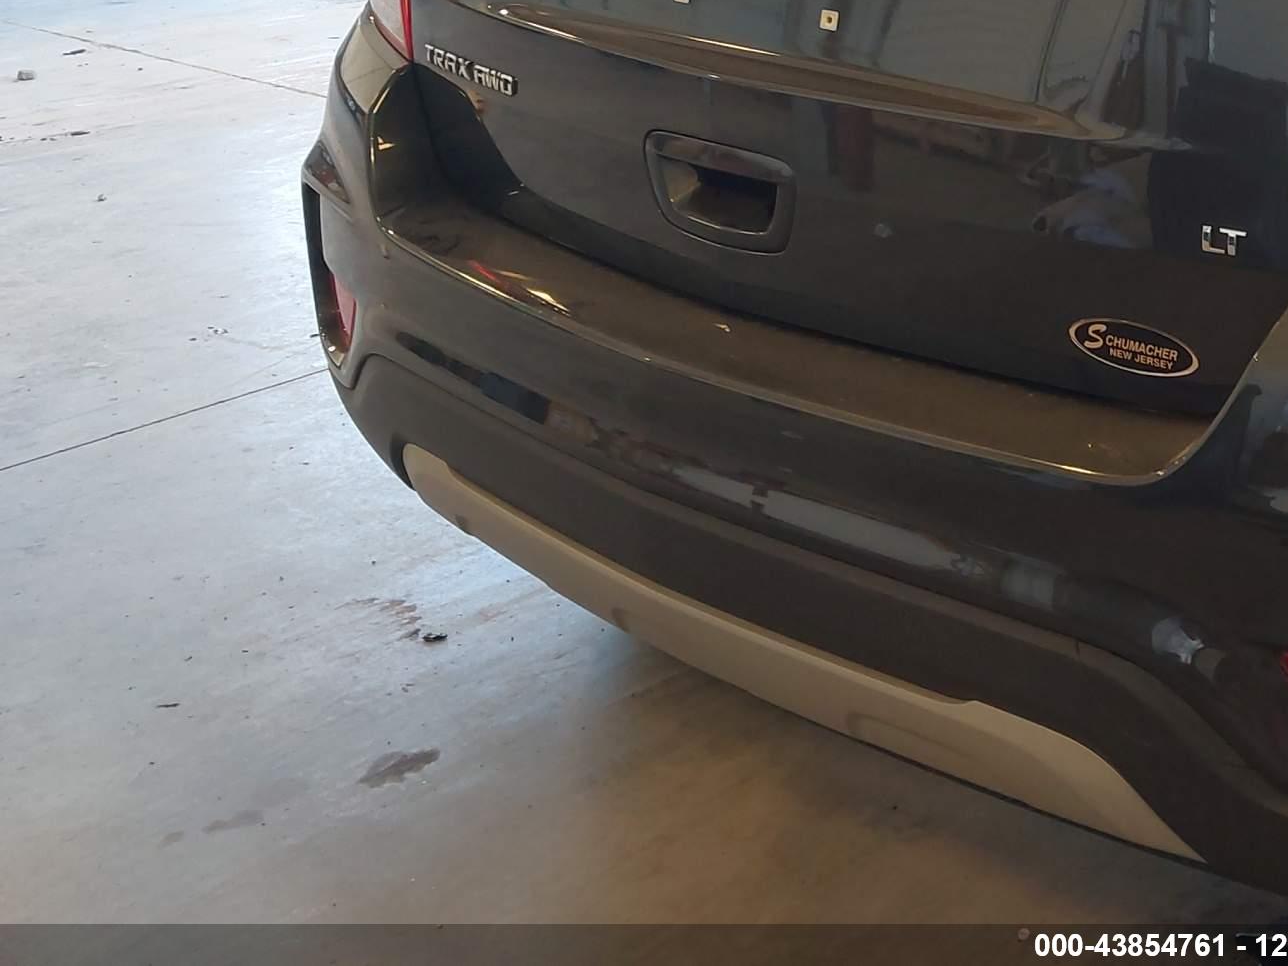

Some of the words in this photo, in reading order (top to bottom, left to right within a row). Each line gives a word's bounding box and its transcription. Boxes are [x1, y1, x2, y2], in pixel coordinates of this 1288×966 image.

[425, 43, 472, 81] TRAX
[473, 64, 516, 96] AWD
[1202, 225, 1247, 256] LT
[1083, 323, 1179, 361] SCHUMACHER
[1109, 348, 1133, 361] NEW
[1134, 354, 1174, 370] JERSEY
